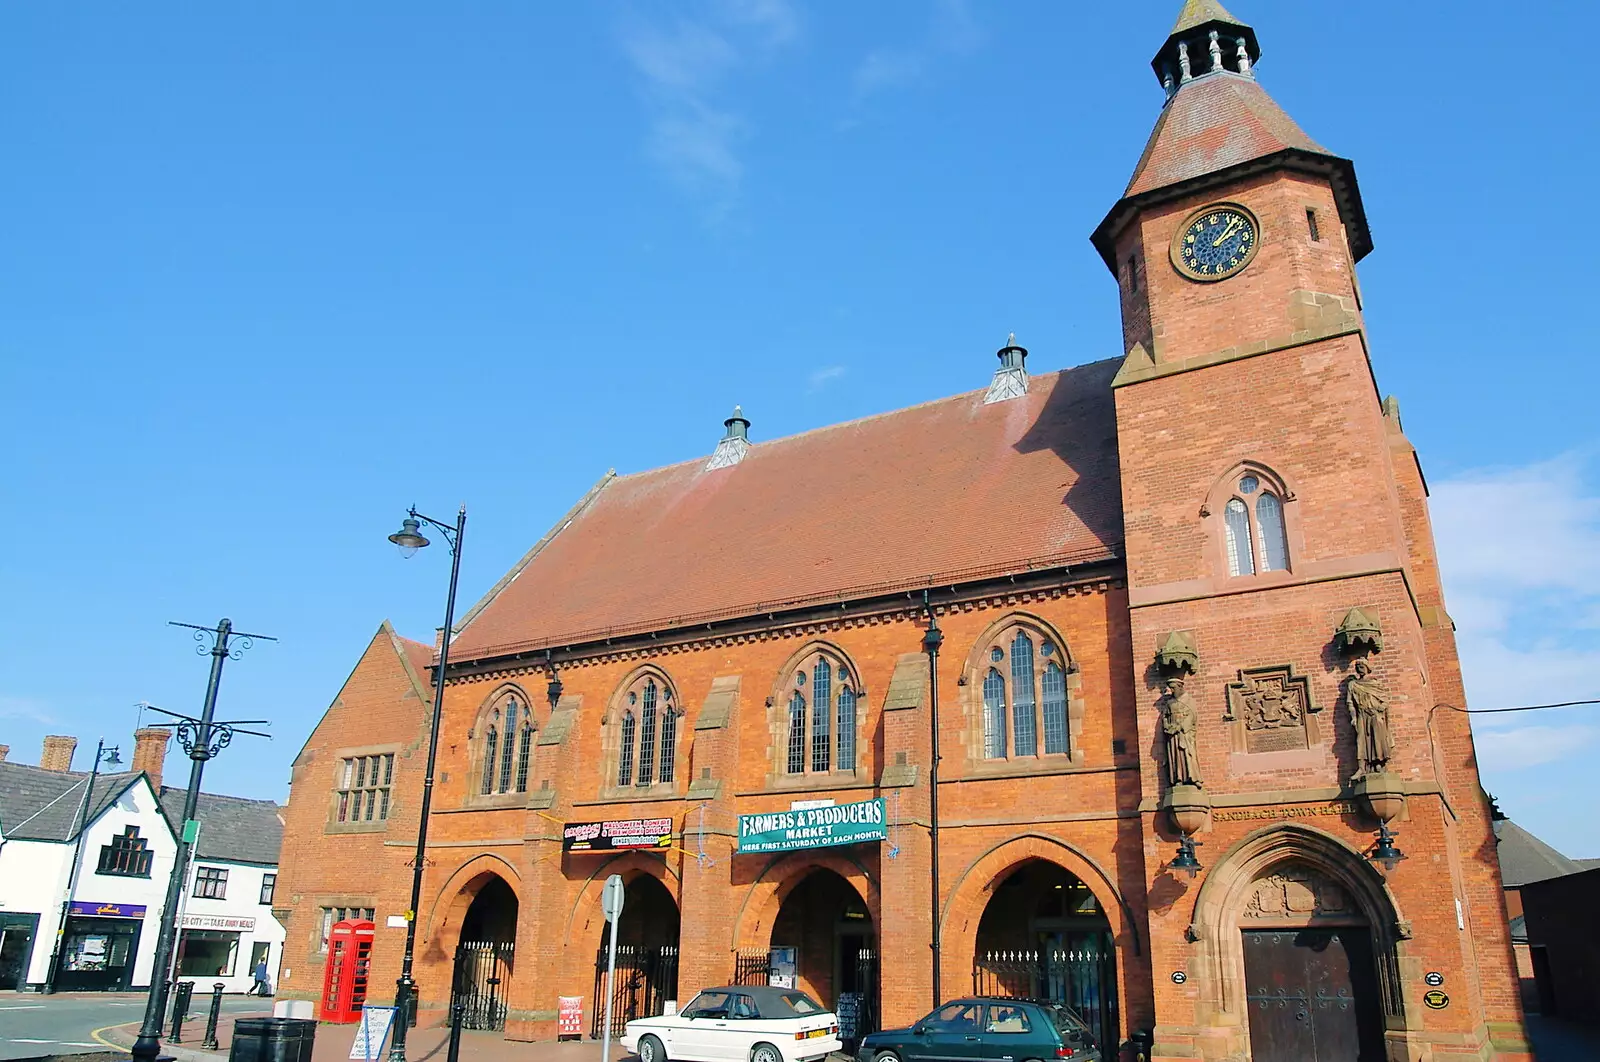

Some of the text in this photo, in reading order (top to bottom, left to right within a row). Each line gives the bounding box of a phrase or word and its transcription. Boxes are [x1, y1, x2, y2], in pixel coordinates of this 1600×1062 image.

[1242, 231, 1249, 241] 3
[1185, 247, 1192, 257] 9
[1190, 258, 1197, 267] 8
[1231, 257, 1238, 266] 5
[1216, 264, 1224, 273] 6
[1212, 804, 1356, 822] SANDBACH TOWN HALL
[742, 800, 882, 838] FARMERS & PRODUCERS
[608, 828, 644, 837] FIREWORKS
[645, 826, 671, 835] DISPLAY
[785, 825, 834, 840] MARKET
[741, 831, 882, 851] HERE FIRST SATURDAY OF EACH MONTH
[190, 917, 202, 926] CITY
[210, 918, 224, 927] TAKE
[239, 920, 254, 928] MEALS
